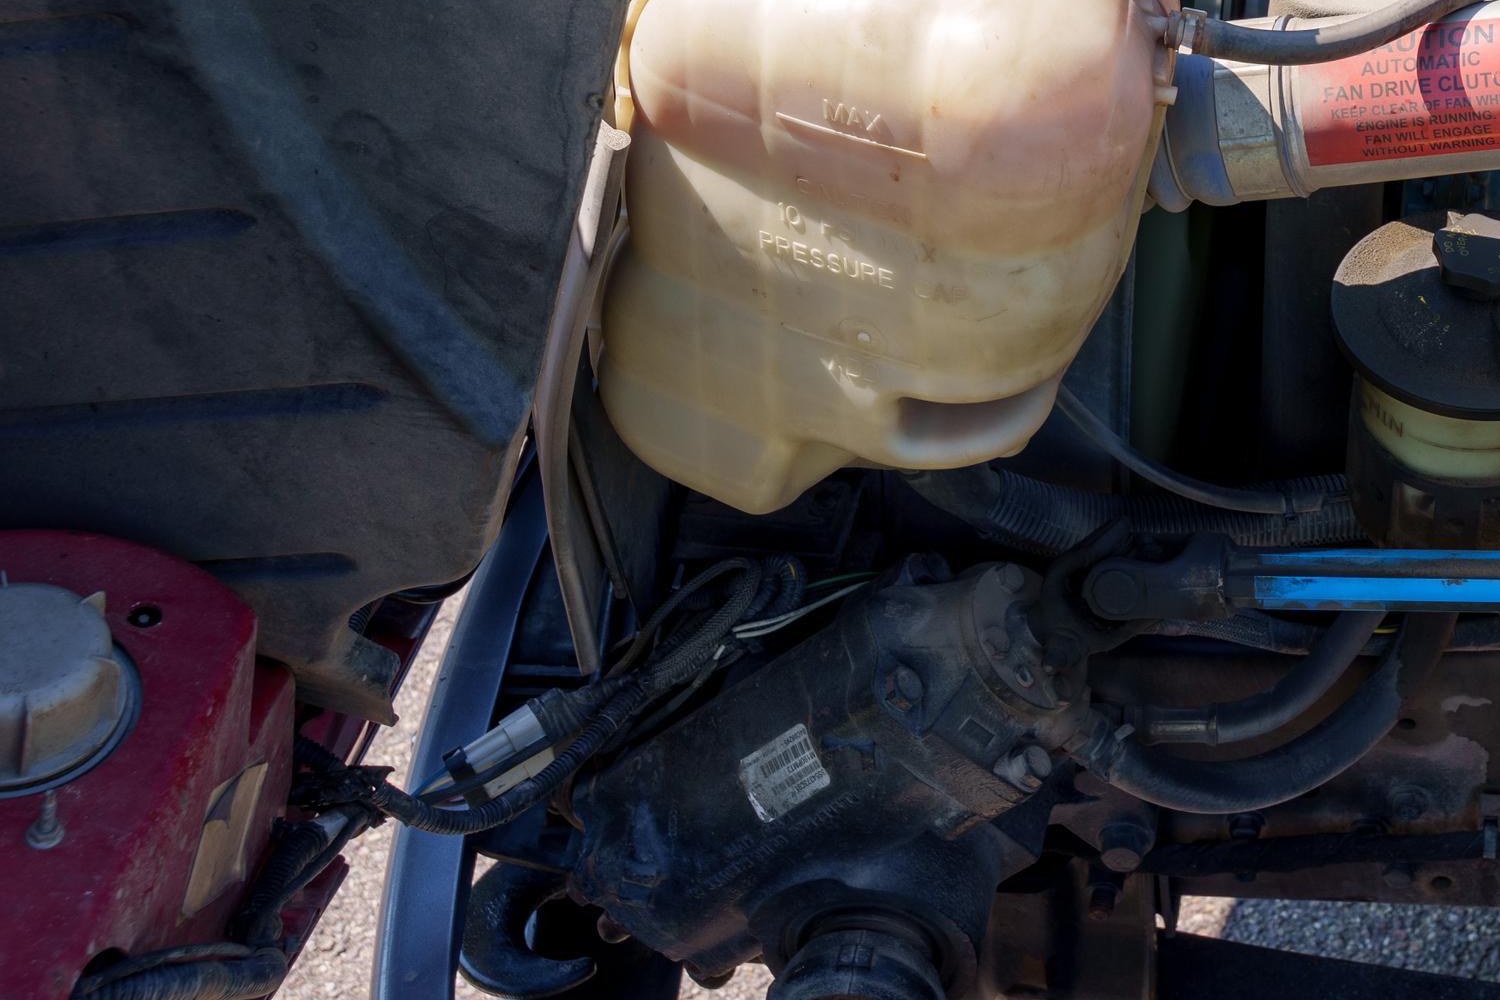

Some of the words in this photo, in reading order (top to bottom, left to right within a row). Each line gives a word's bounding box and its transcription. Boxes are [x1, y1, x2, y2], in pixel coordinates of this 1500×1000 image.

[1372, 23, 1494, 55] UTION
[1361, 50, 1480, 77] AUTOMATIC
[1323, 84, 1363, 104] FAN
[1370, 77, 1432, 99] DRIVE
[823, 97, 882, 132] MAX
[1330, 105, 1367, 121] KEEP
[1371, 101, 1418, 116] CLEAR
[1423, 100, 1441, 112] OF
[1445, 96, 1472, 110] FAN
[1355, 117, 1408, 133] ENGINE
[1412, 116, 1426, 127] IS
[1429, 110, 1497, 126] RUNNING.
[1361, 143, 1425, 157] WITHOUT
[1429, 136, 1500, 151] WARNING.
[1364, 132, 1393, 146] FAN
[1395, 130, 1428, 142] WILL
[1433, 124, 1493, 139] ENGAGE
[777, 201, 804, 227] 10
[758, 229, 896, 290] PRESSURE
